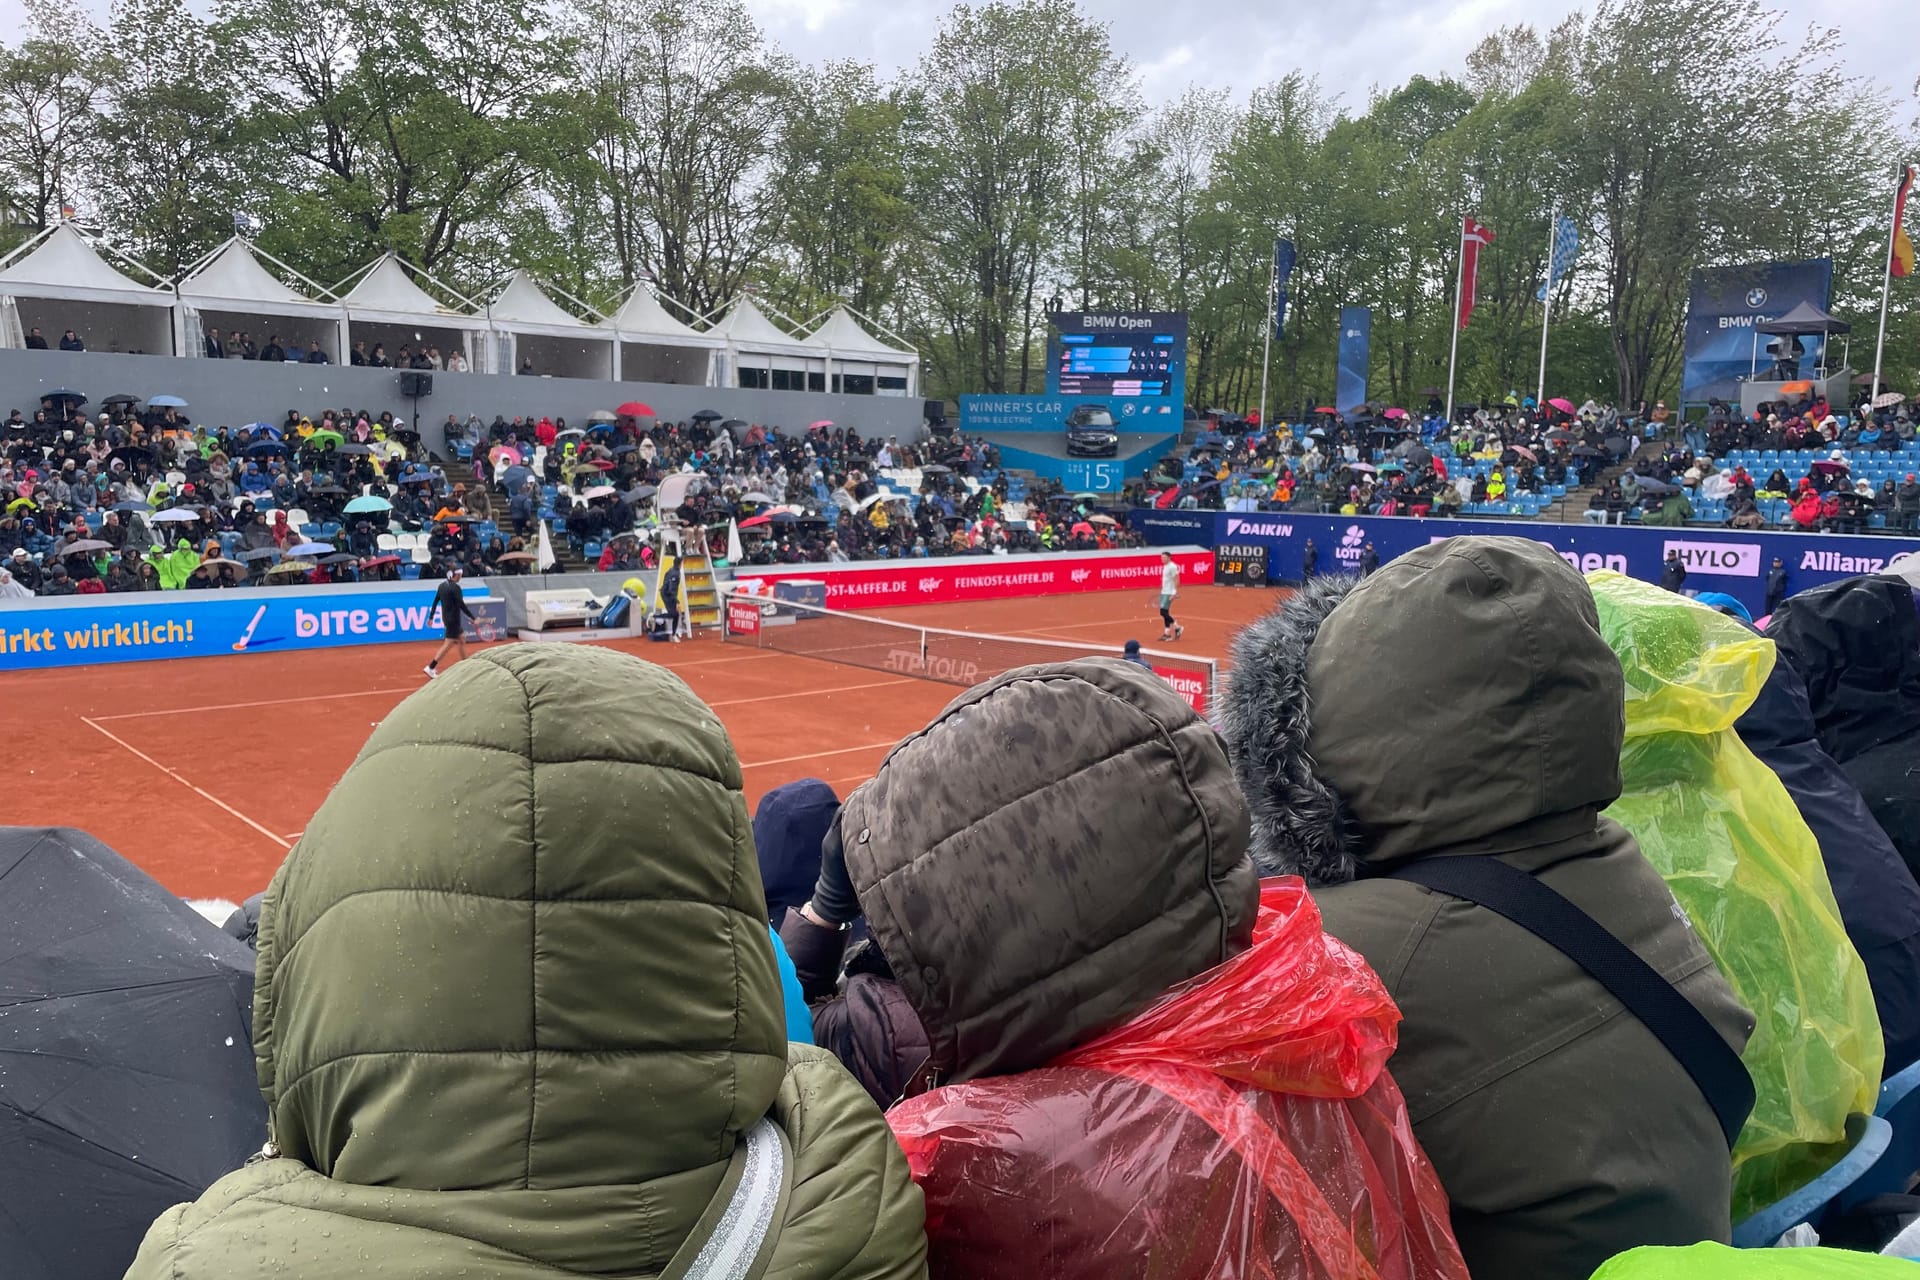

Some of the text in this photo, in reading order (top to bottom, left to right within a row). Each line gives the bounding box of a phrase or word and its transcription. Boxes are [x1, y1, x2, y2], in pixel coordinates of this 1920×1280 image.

[1083, 316, 1152, 330] BMW Open
[1719, 315, 1753, 329] BMW
[968, 402, 1063, 414] WINNER'S CAR
[993, 416, 1033, 425] ELECTRIC
[1240, 522, 1293, 537] DAIKIN
[1220, 545, 1264, 557] RADO
[1335, 547, 1362, 560] LOTT
[1678, 549, 1740, 568] HYLO
[1800, 550, 1884, 573] Allianz
[375, 606, 445, 632] awa
[730, 607, 758, 621] Emirates
[64, 619, 194, 649] wirklich!
[926, 655, 978, 684] TOUR
